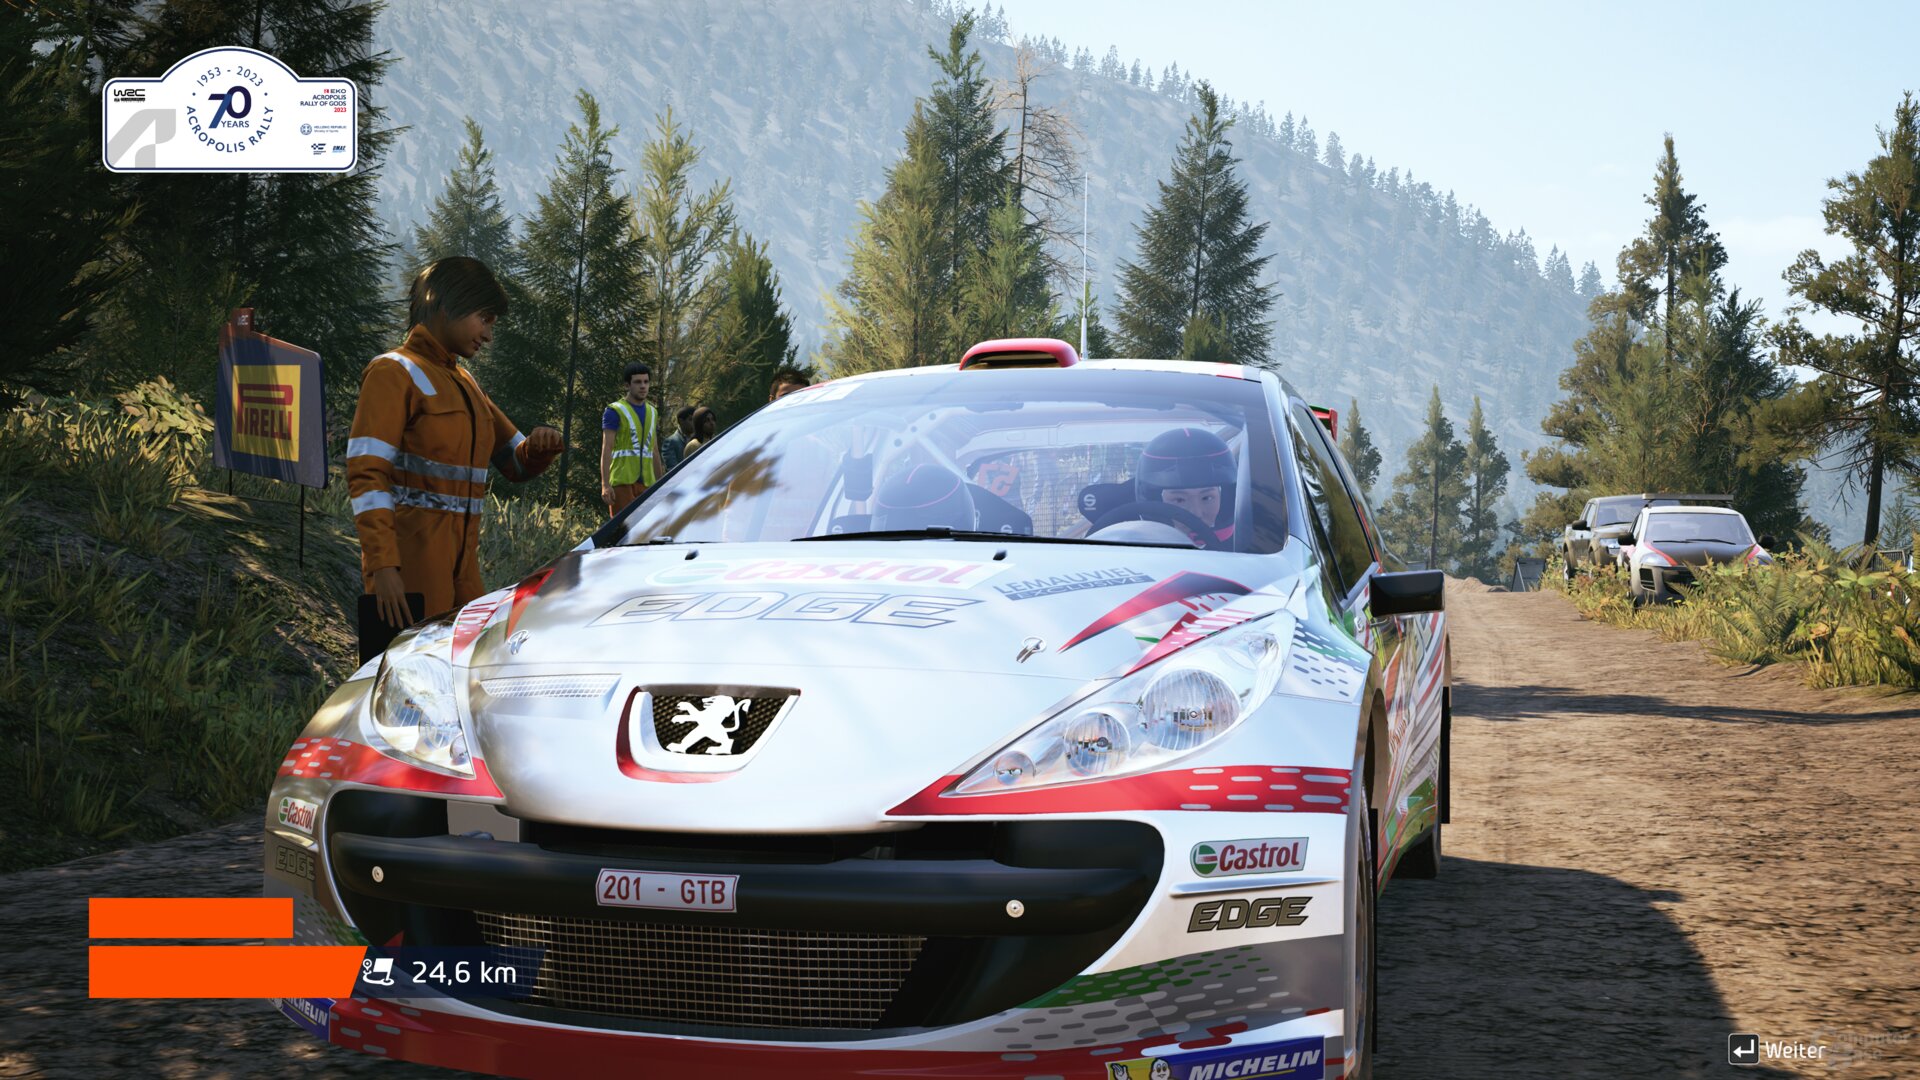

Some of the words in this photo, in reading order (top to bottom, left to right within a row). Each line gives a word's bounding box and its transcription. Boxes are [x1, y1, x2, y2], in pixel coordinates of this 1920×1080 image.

[237, 384, 293, 440] PIRELLI
[723, 560, 983, 584] Castrol
[992, 567, 1144, 594] LEMAUVIEL
[1015, 577, 1147, 599] EXCLUSIVE
[583, 591, 985, 629] EDGE
[287, 801, 315, 830] Castrol
[275, 845, 316, 881] EDGE
[1219, 842, 1300, 871] Castrol
[603, 875, 641, 901] 201
[680, 879, 725, 905] GTB
[1187, 896, 1313, 933] EDGE
[1188, 1049, 1321, 1080] MICHELIN
